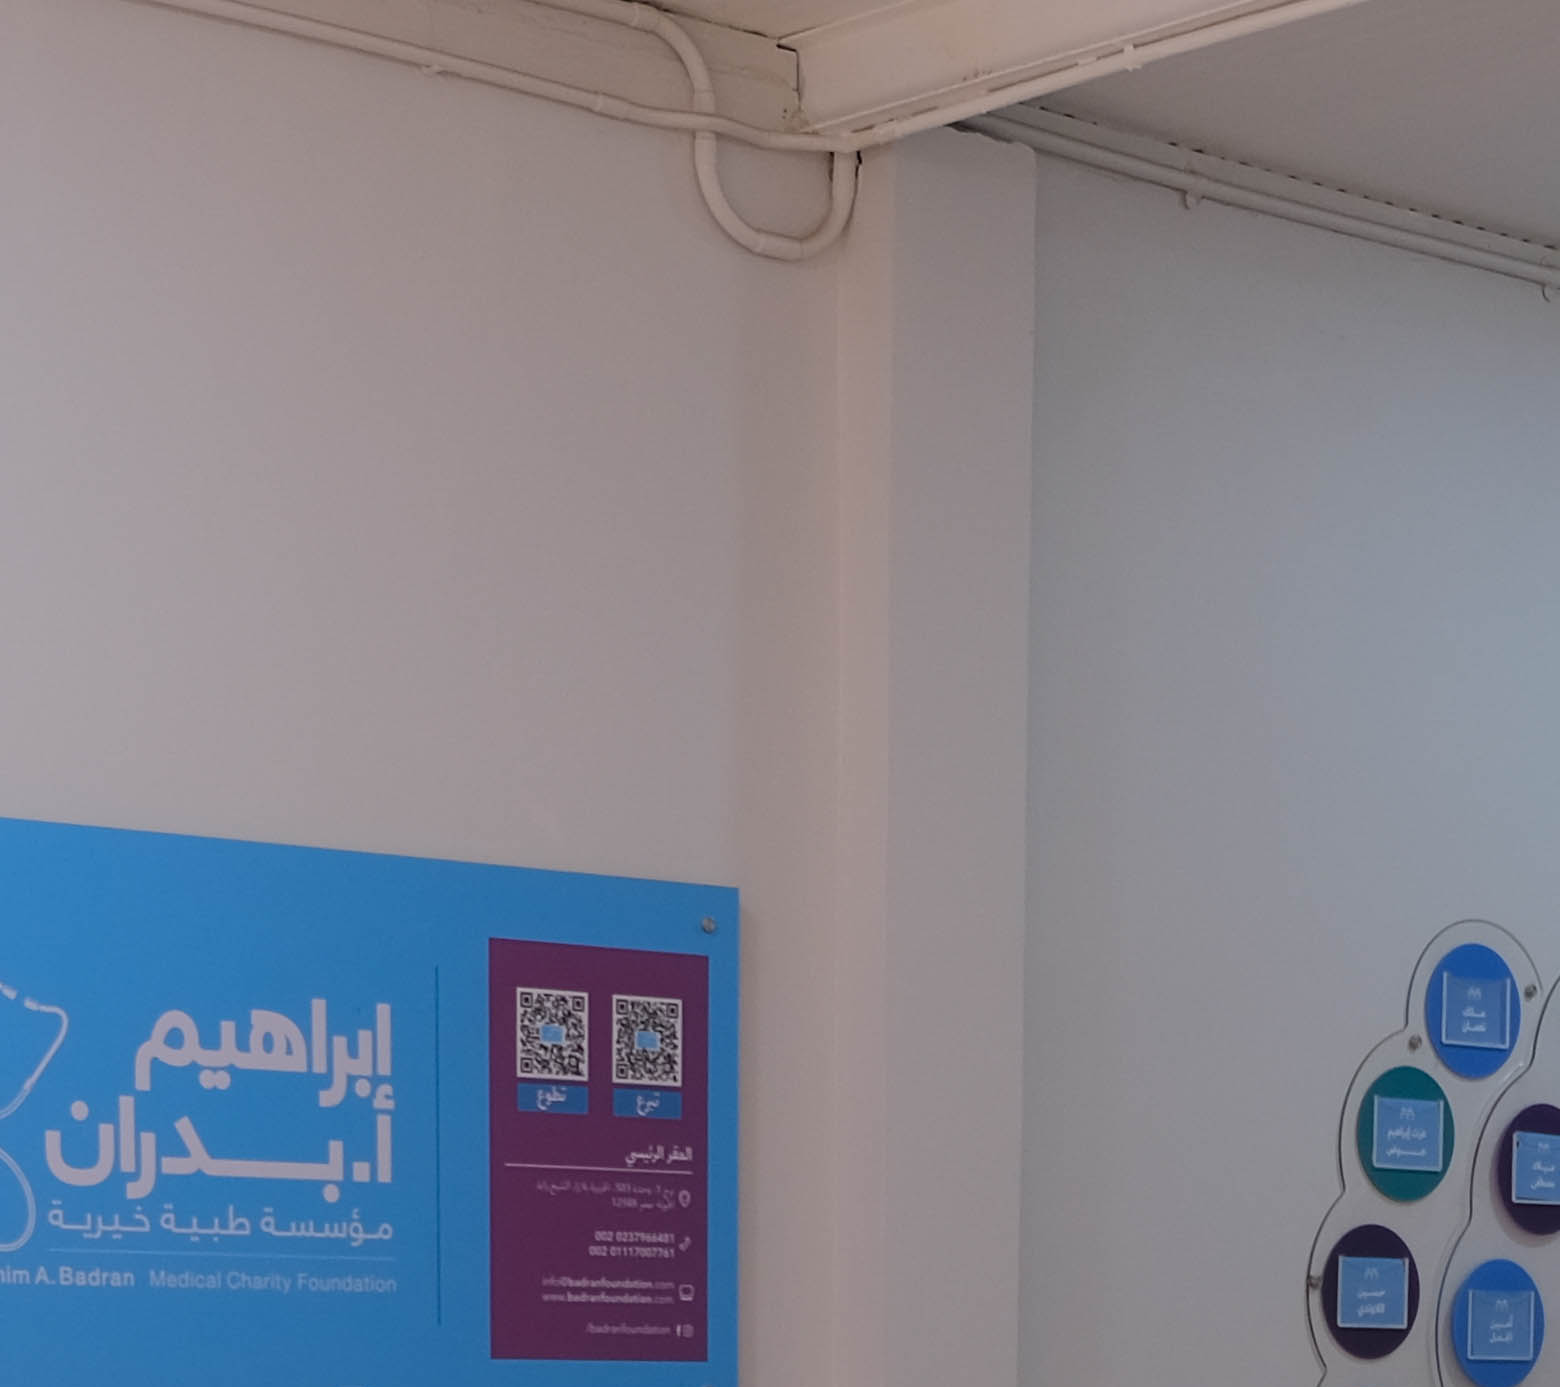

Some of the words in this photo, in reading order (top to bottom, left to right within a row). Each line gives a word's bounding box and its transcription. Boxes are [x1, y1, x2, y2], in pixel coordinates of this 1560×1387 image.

[134, 998, 394, 1109] إبراهيم
[46, 1199, 150, 1240] خيرية
[159, 1204, 251, 1242] طبية
[258, 1205, 394, 1247] مؤسسة
[34, 1267, 56, 1286] A.
[59, 1266, 135, 1288] Badran
[149, 1269, 222, 1290] Medical
[227, 1270, 290, 1295] Charity
[297, 1273, 398, 1294] Foundation
